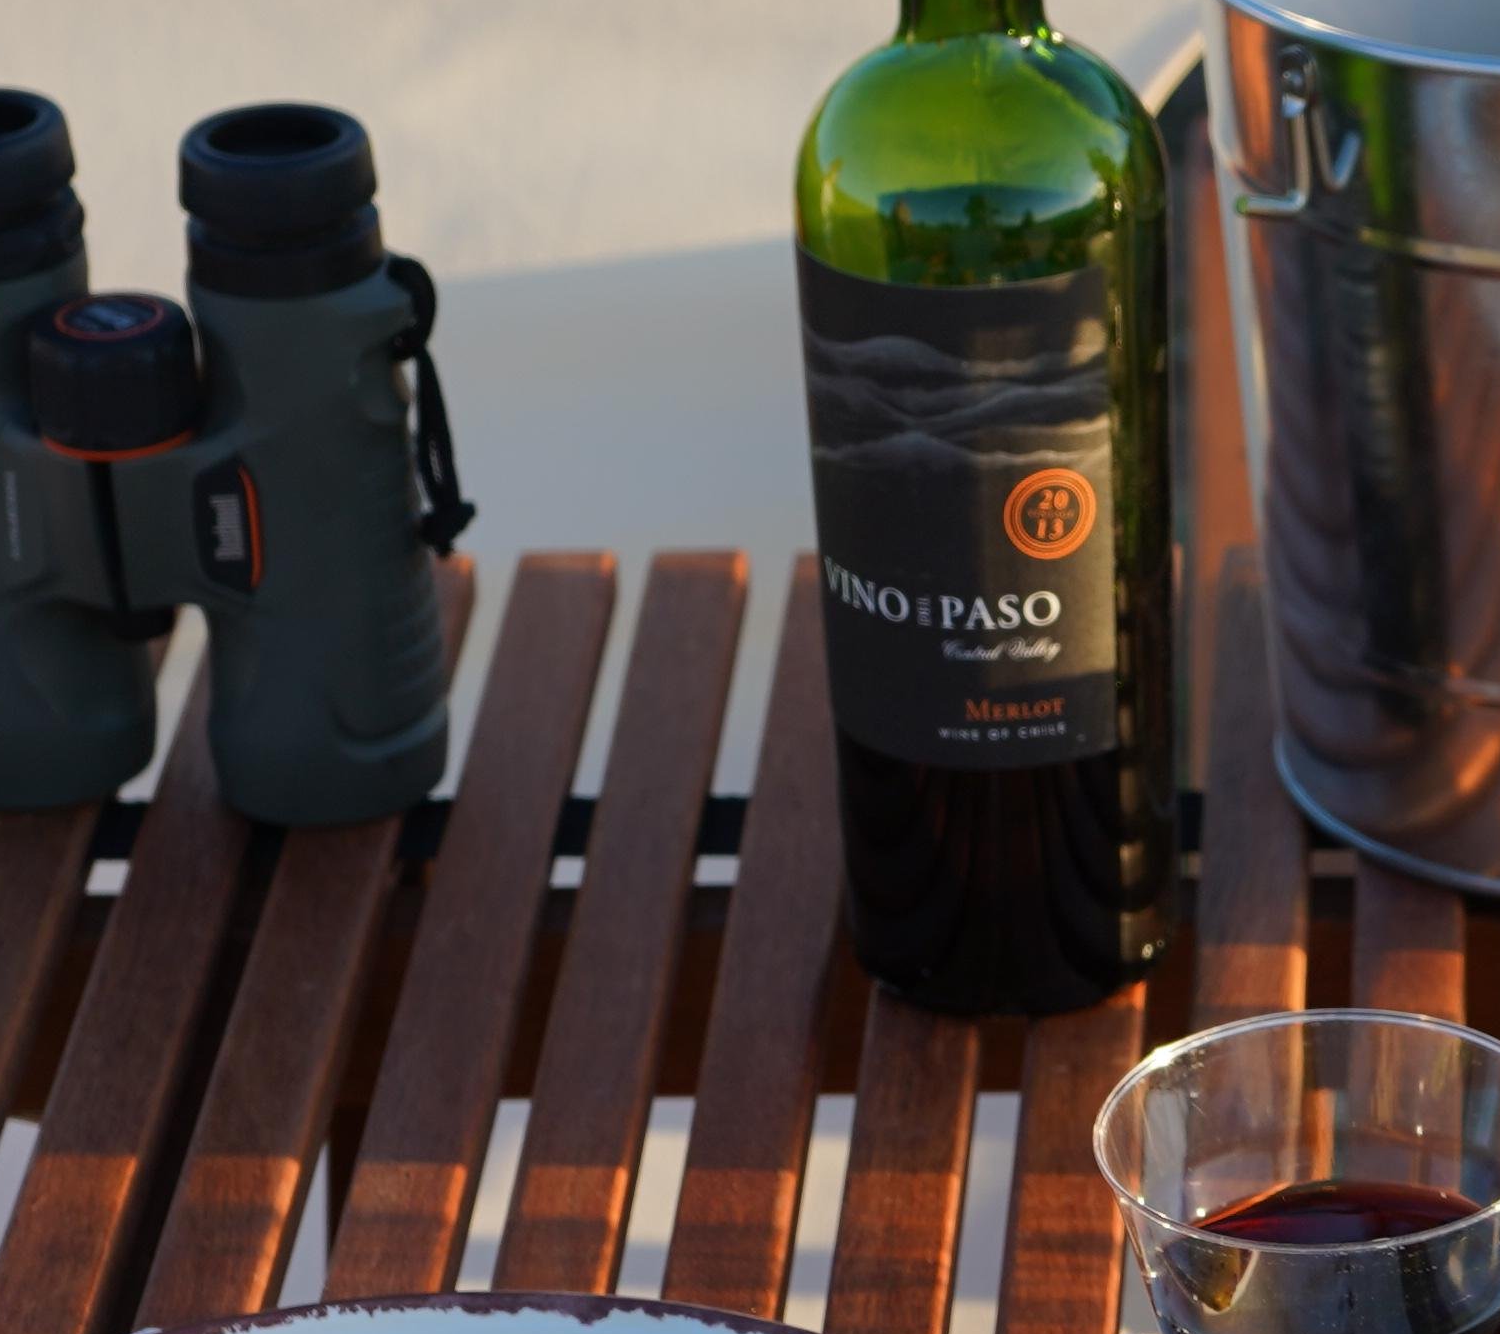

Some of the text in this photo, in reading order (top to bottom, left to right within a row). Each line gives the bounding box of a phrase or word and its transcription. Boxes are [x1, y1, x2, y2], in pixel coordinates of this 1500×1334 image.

[1038, 489, 1069, 510] 20
[825, 555, 910, 623] VINO
[939, 590, 1061, 630] PASO
[1004, 636, 1061, 662] Valley
